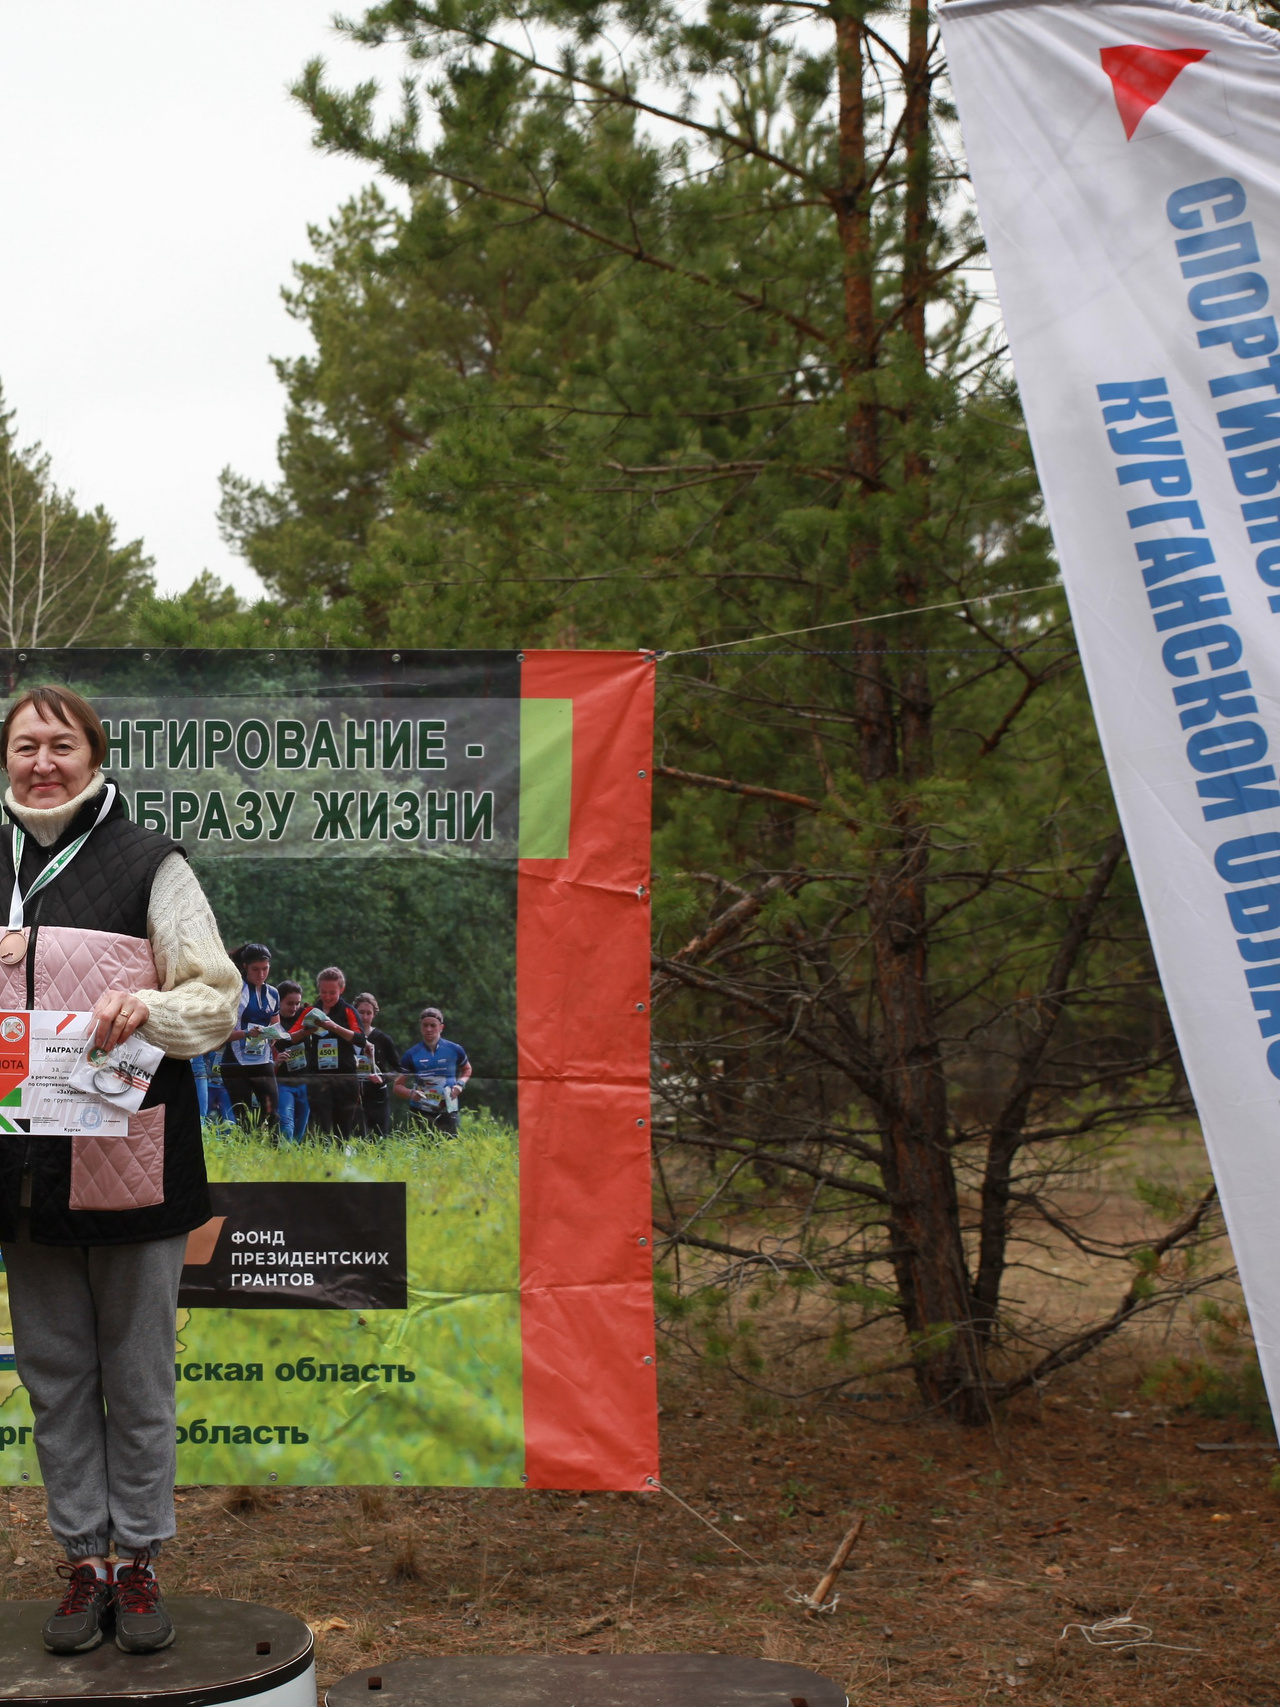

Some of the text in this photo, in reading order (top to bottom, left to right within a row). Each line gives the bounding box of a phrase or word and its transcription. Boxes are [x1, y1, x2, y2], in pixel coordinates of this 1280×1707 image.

[312, 791, 494, 841] ЖИЗНИ
[231, 1230, 285, 1246] ФОНД
[231, 1251, 389, 1267] ПРЕЗИДЕНТСКИХ
[231, 1273, 315, 1287] ГРАНТОВ
[275, 1357, 416, 1383] область
[175, 1418, 309, 1444] область
